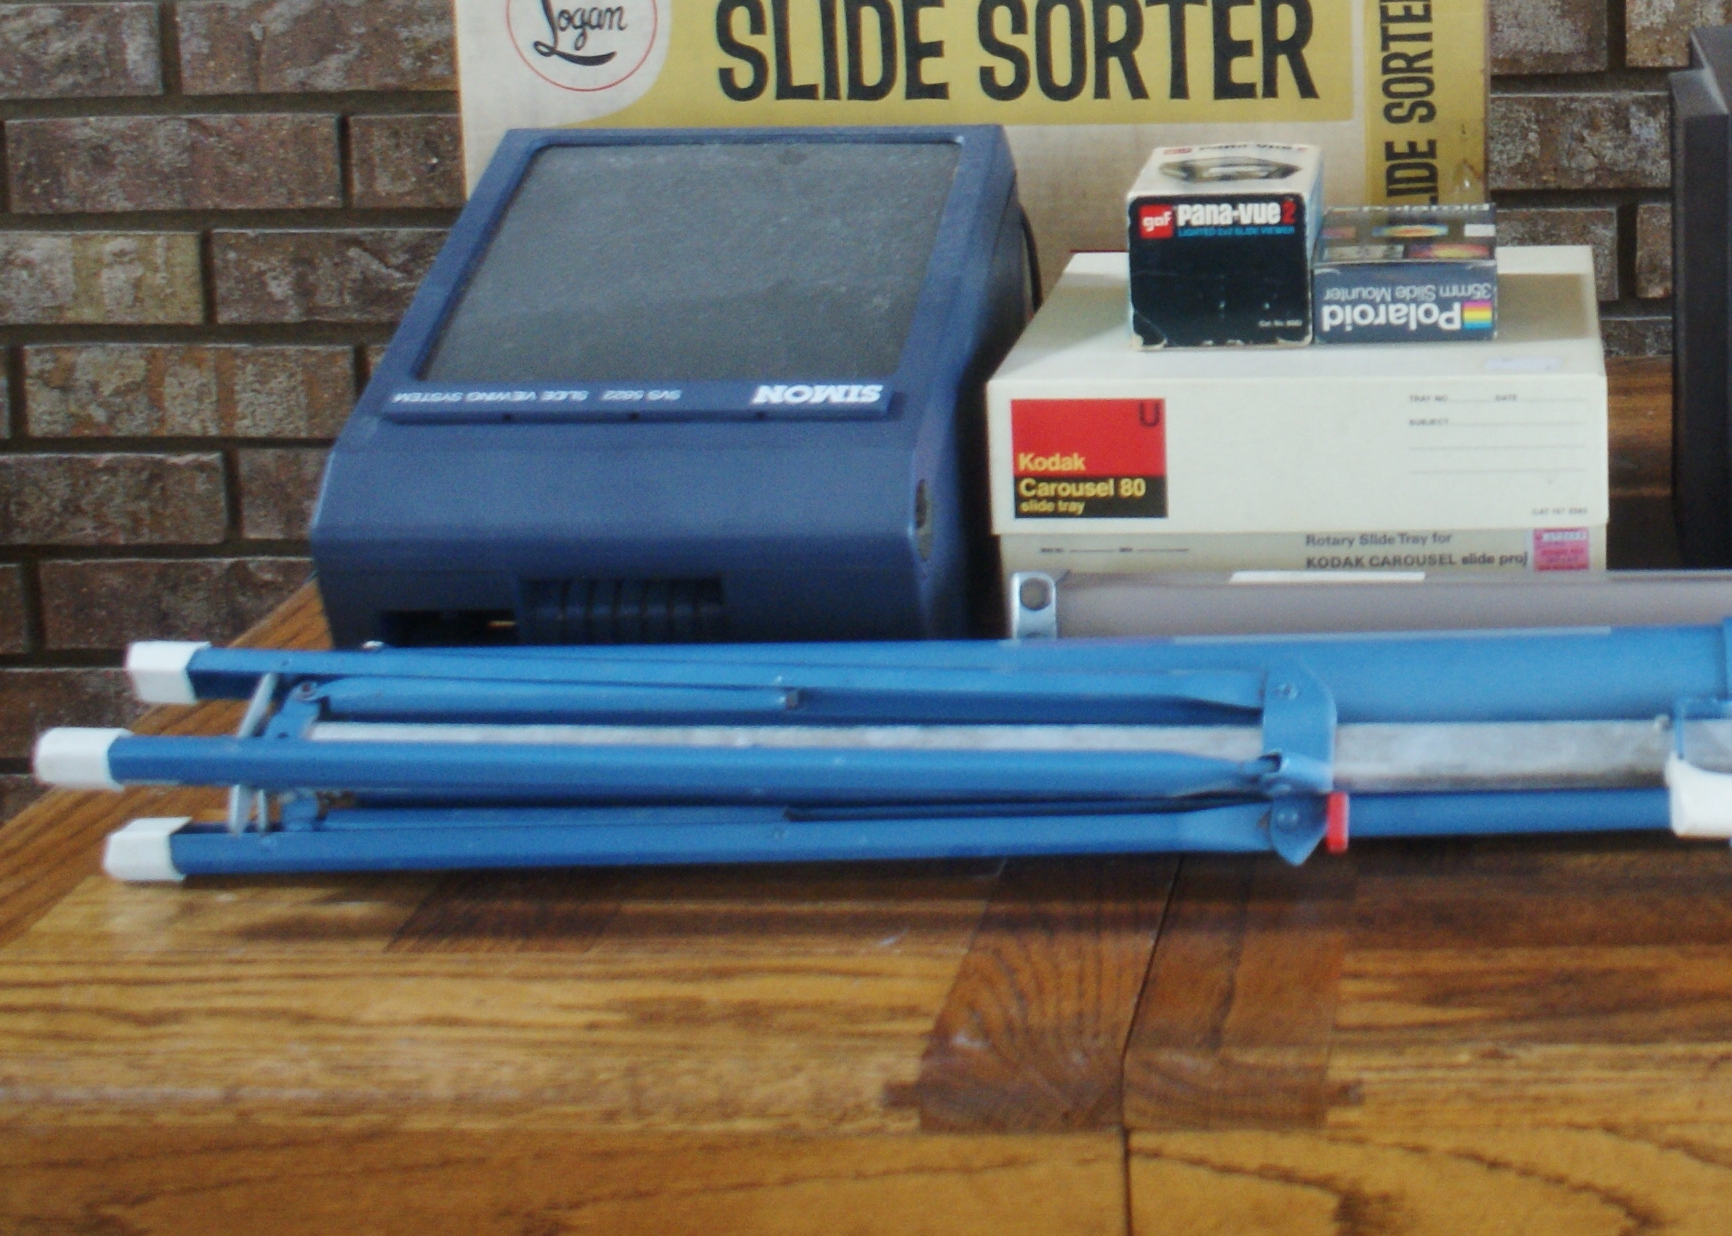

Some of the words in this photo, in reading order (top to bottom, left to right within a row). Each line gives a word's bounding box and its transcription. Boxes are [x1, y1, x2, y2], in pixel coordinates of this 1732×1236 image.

[1384, 139, 1438, 205] IDE
[1142, 210, 1172, 233] gaf
[1324, 286, 1392, 302] Mounter
[1395, 284, 1437, 301] Slide
[1438, 282, 1492, 300] 35mm
[1322, 301, 1462, 332] Polaroid
[392, 391, 464, 403] SYSTEM
[752, 384, 884, 404] SIMON
[1138, 401, 1160, 427] U
[1018, 452, 1086, 471] Kodak
[1019, 477, 1115, 498] Carousel
[1119, 477, 1147, 498] 80
[1020, 499, 1055, 512] slide
[1057, 500, 1086, 516] tray
[1306, 534, 1355, 548] Rotary
[1360, 533, 1395, 545] Slide
[1397, 532, 1429, 546] Tray
[1432, 531, 1453, 544] for
[1306, 555, 1366, 569] KODAK
[1368, 553, 1457, 567] CAROUSEL
[1461, 552, 1496, 565] slide
